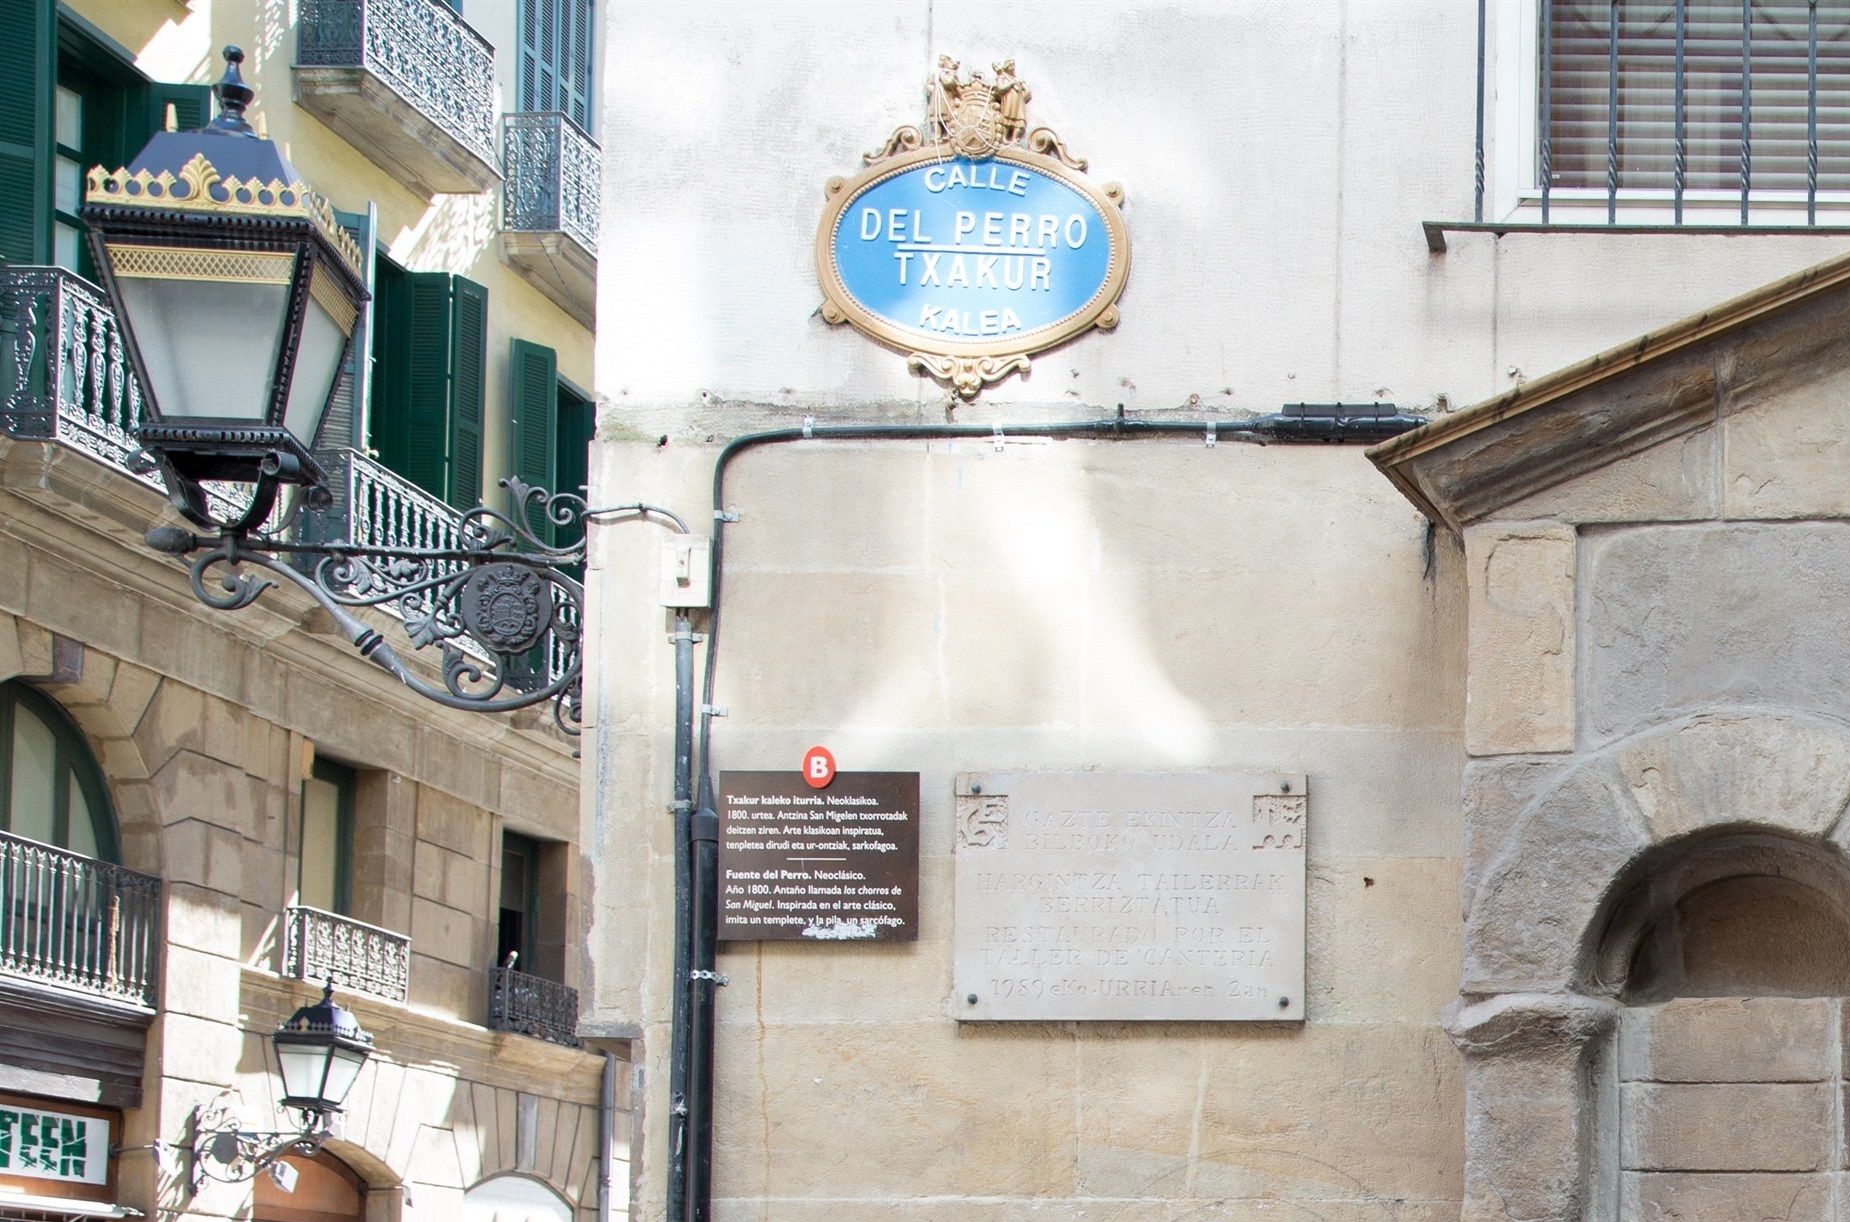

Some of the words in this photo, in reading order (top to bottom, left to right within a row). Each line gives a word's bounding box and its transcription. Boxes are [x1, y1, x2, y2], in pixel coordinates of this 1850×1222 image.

[924, 165, 1031, 196] CALLE
[861, 208, 934, 243] DEL
[954, 212, 1088, 250] PERRO
[894, 252, 1052, 291] TXAKUR
[920, 304, 1022, 336] KALEA
[810, 756, 829, 779] B
[726, 795, 760, 805] Txakur
[761, 795, 791, 805] kaleko
[793, 795, 825, 805] iturria.
[827, 796, 879, 806] Neoklasikoa.
[727, 810, 749, 820] 1800.
[751, 812, 775, 820] urtea.
[777, 810, 808, 820] Antzina
[809, 811, 824, 820] San
[826, 811, 858, 823] Migelen
[859, 811, 908, 821] txorrotadak
[1023, 810, 1113, 829] GAZTE
[1126, 810, 1239, 829] EKINTZA
[726, 825, 756, 835] deitzen
[758, 826, 781, 835] ziren.
[783, 826, 802, 835] Arte
[803, 825, 841, 835] klasikoan
[842, 826, 884, 837] inspiratua,
[726, 840, 764, 852] tenpletea
[766, 840, 790, 850] dirudi
[791, 842, 804, 850] eta
[806, 841, 851, 851] ur-ontziak,
[852, 841, 898, 852] sarkofagoa.
[1024, 833, 1136, 852] BILBOKO
[1151, 833, 1240, 852] UDALA
[725, 869, 761, 880] Fuente
[763, 870, 778, 880] del
[780, 870, 812, 880] Perro.
[814, 870, 866, 880] Neoclásico.
[976, 872, 1121, 891] HARGINTZA
[1137, 872, 1287, 891] TAILERRAK
[725, 885, 744, 894] Año
[747, 885, 772, 894] 1800.
[773, 885, 806, 894] Antaño
[808, 885, 842, 895] llamada
[843, 885, 856, 895] los
[858, 885, 889, 895] chorros
[891, 885, 902, 895] de
[725, 900, 741, 909] San
[742, 900, 775, 912] Miguel.
[777, 900, 818, 912] Inspirada
[819, 902, 831, 910] en
[832, 900, 841, 910] el
[842, 901, 862, 910] arte
[863, 900, 896, 911] clásico,
[725, 915, 748, 925] imita
[750, 917, 761, 925] un
[763, 915, 807, 927] templete,
[816, 915, 824, 925] la
[847, 917, 858, 925] un
[859, 915, 905, 927] sarcófago.
[985, 926, 1158, 945] RESTAURADO
[1173, 926, 1225, 945] POR
[1238, 926, 1272, 945] EL
[979, 948, 1081, 967] TALLER
[1096, 948, 1129, 967] DE
